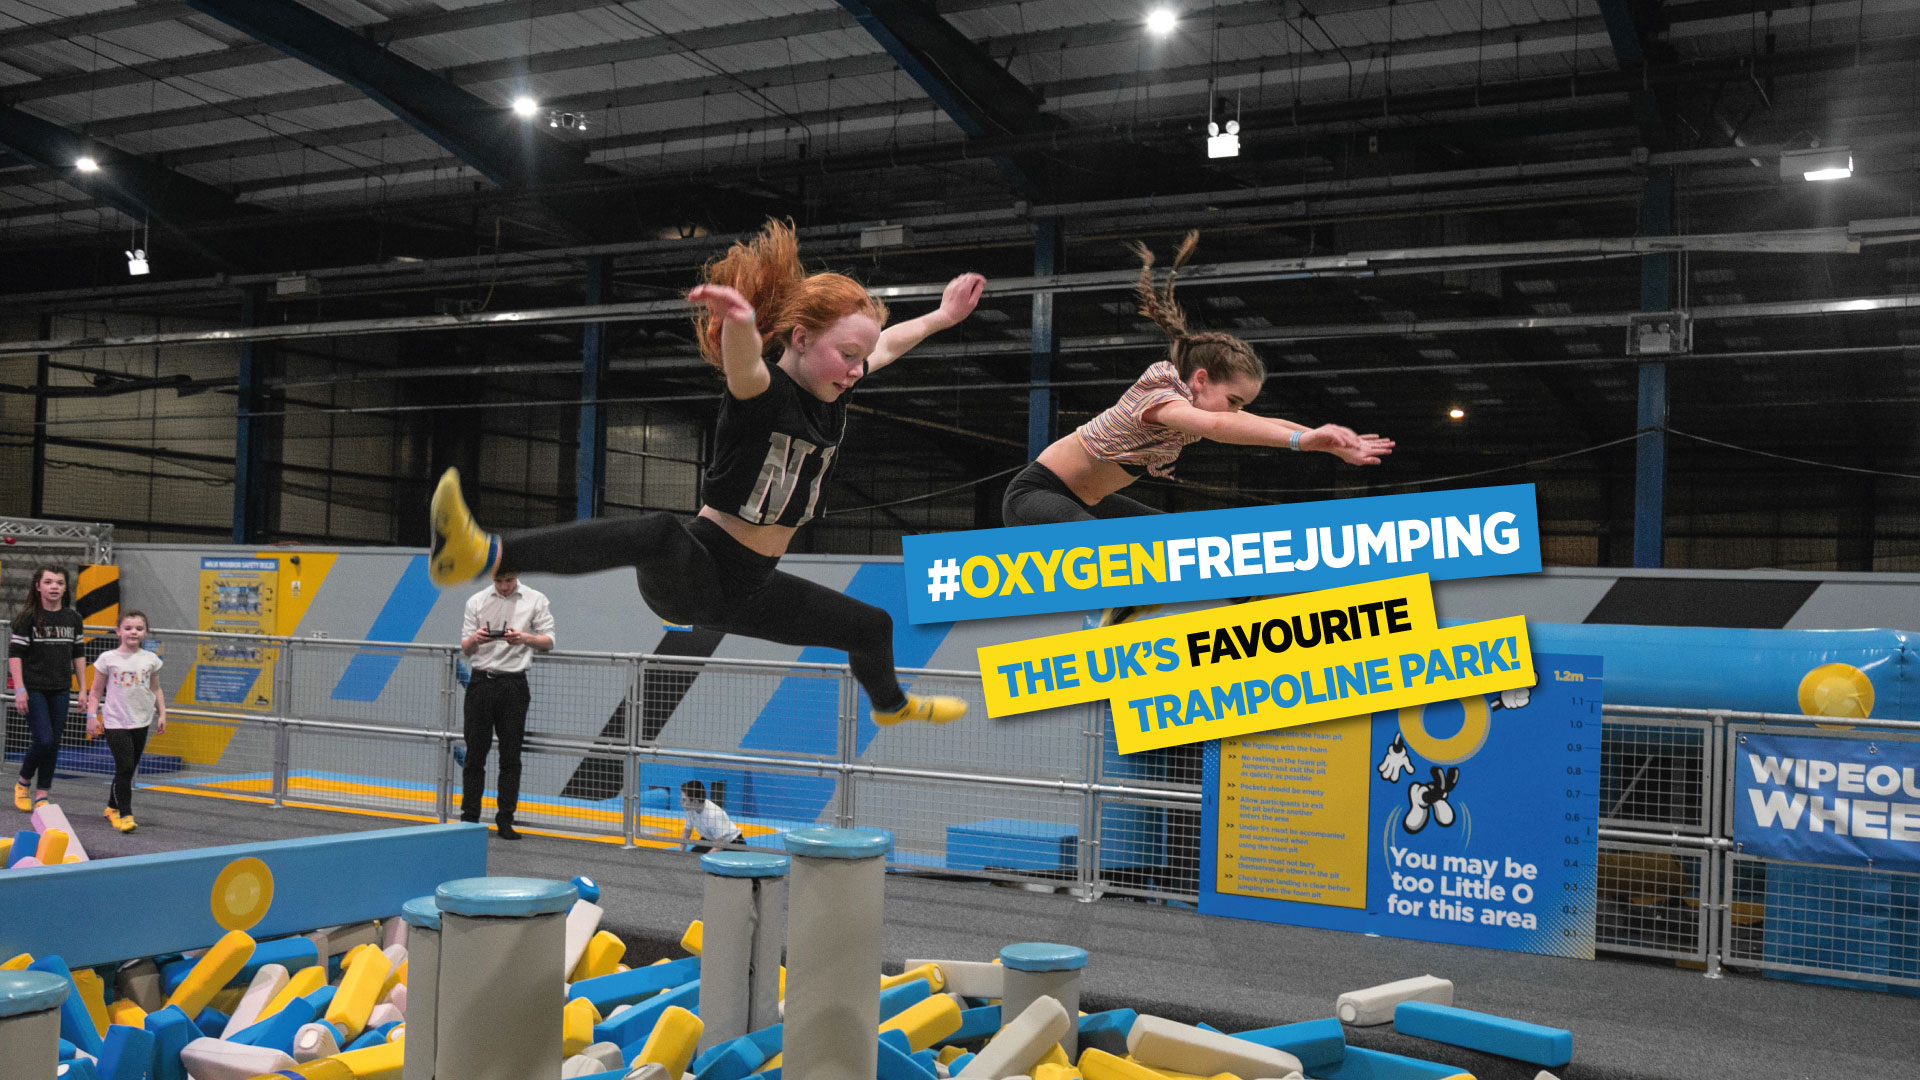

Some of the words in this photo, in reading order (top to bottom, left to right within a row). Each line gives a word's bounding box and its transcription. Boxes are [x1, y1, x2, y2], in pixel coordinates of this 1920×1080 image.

[1554, 670, 1584, 682] 1.2m
[1572, 697, 1583, 705] 1.1
[1570, 720, 1582, 729] 1.0
[1567, 743, 1582, 752] 0.9
[1567, 766, 1581, 776] 0.8
[1566, 790, 1580, 798] 0.7
[1565, 812, 1579, 822] 0.6
[1748, 788, 1920, 841] WHEE
[1565, 835, 1579, 845] 0.5
[1390, 846, 1436, 870] You
[1443, 856, 1498, 879] may
[1505, 857, 1537, 880] be
[1564, 859, 1578, 868] 0.4
[1392, 872, 1434, 893] too
[1441, 876, 1505, 901] Little
[1512, 883, 1534, 904] O
[1564, 882, 1578, 891] 0.3
[1388, 894, 1423, 916] for
[1429, 899, 1474, 922] this
[1480, 908, 1537, 930] area
[1563, 905, 1577, 914] 0.2
